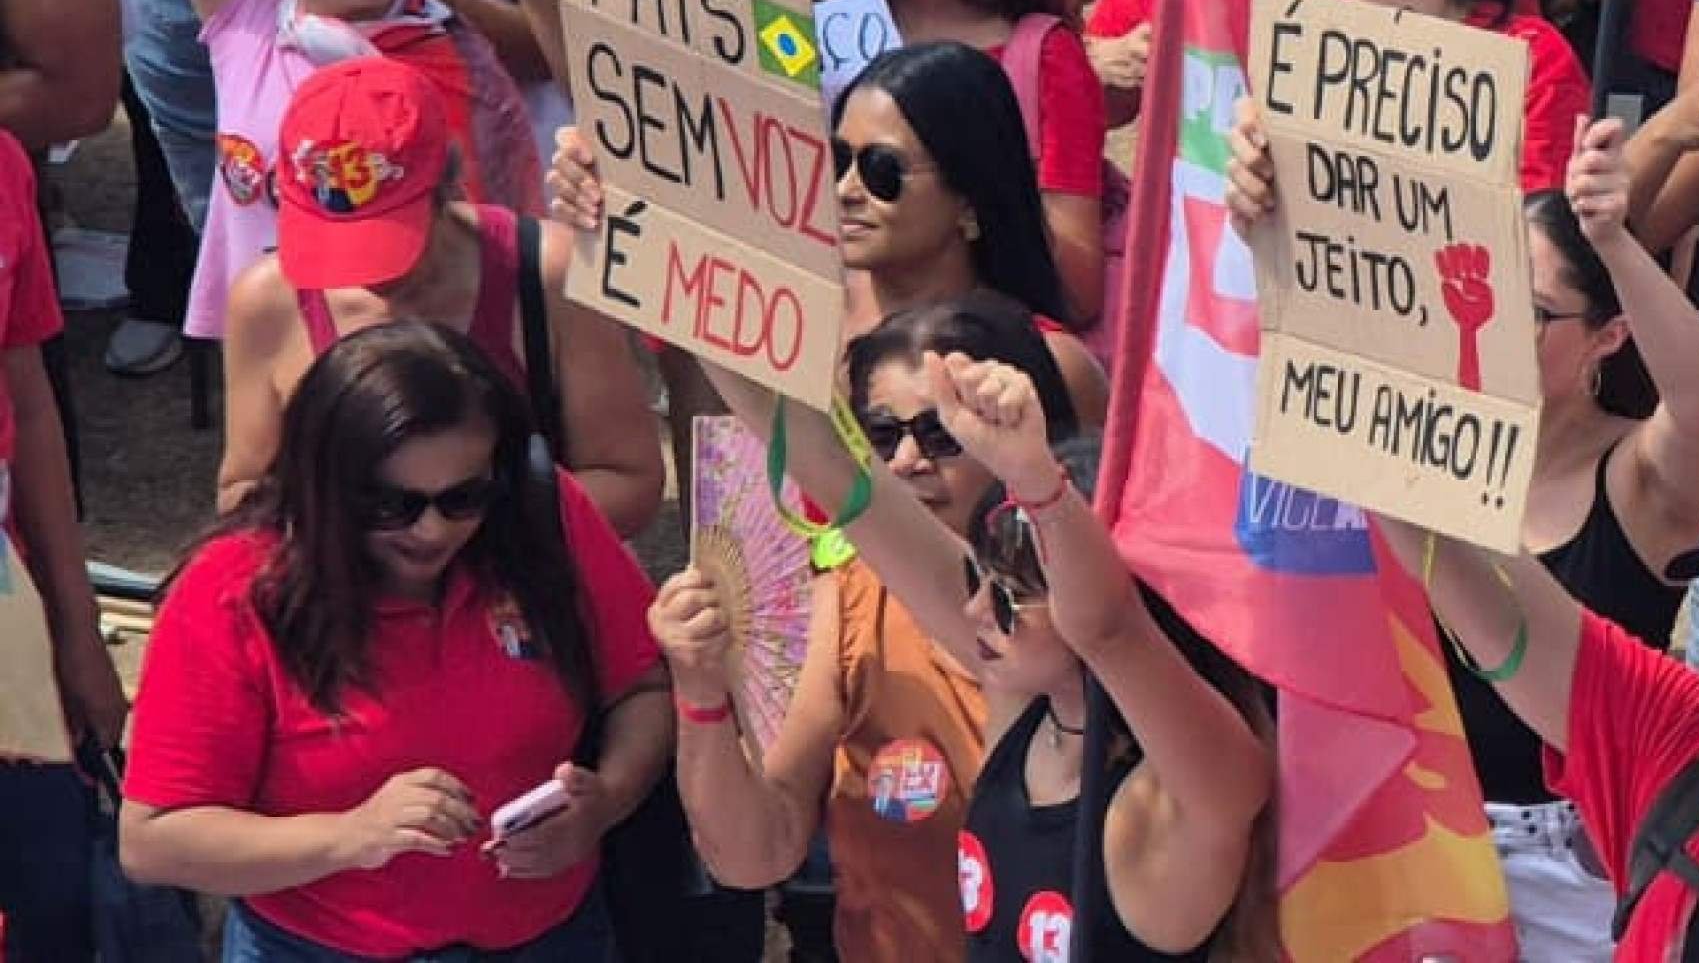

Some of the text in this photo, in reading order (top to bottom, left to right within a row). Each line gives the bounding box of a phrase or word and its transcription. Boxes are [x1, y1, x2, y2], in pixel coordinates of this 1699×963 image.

[586, 42, 839, 248] SEM VOZ
[1312, 29, 1497, 162] PRECISO
[1306, 141, 1454, 241] DAR UM
[601, 198, 804, 373] É MEDO
[1280, 358, 1361, 435] MEU
